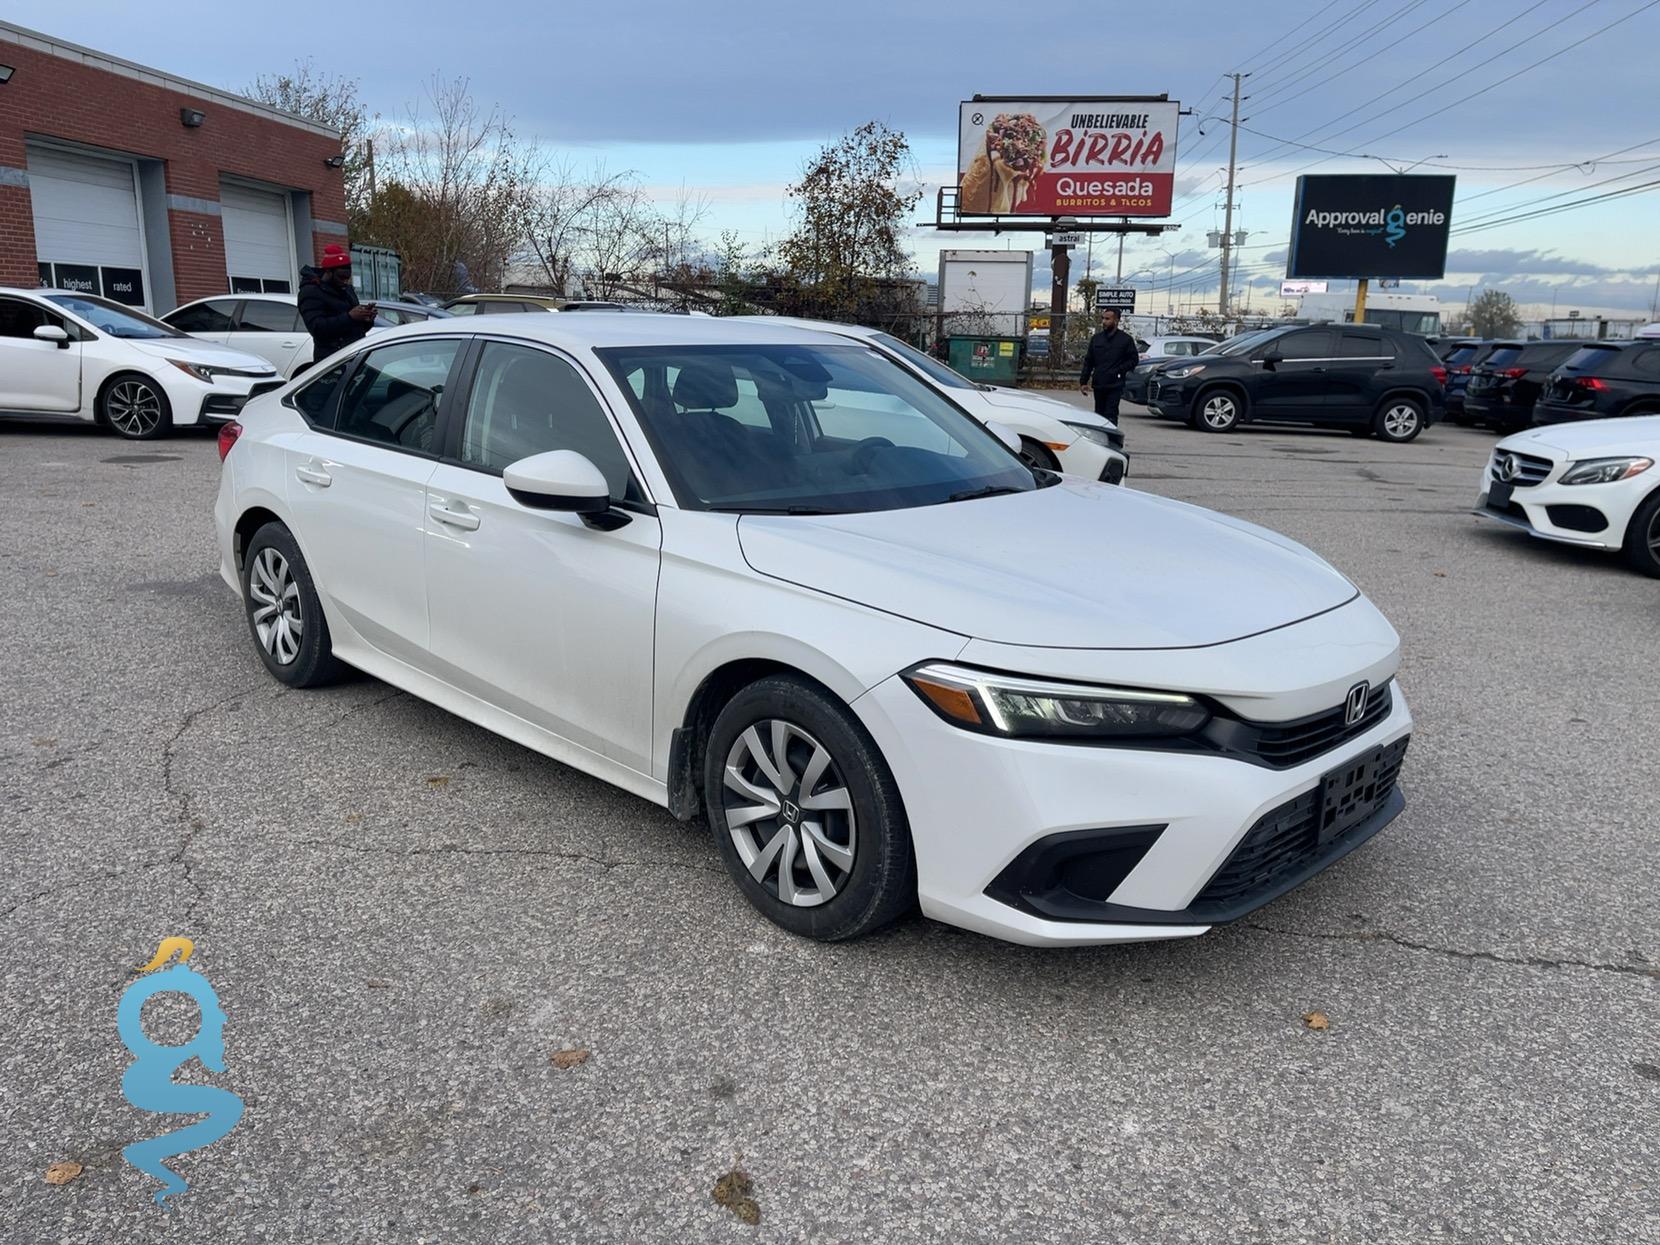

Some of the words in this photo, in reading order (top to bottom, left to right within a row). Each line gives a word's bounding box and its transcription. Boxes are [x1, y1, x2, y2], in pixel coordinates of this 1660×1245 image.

[1070, 114, 1149, 129] UNBELIEVABLE
[1056, 177, 1153, 196] Quesada
[1056, 198, 1106, 206] BURRITOS
[1110, 198, 1117, 206] &
[63, 278, 93, 291] highest
[113, 282, 132, 292] rated
